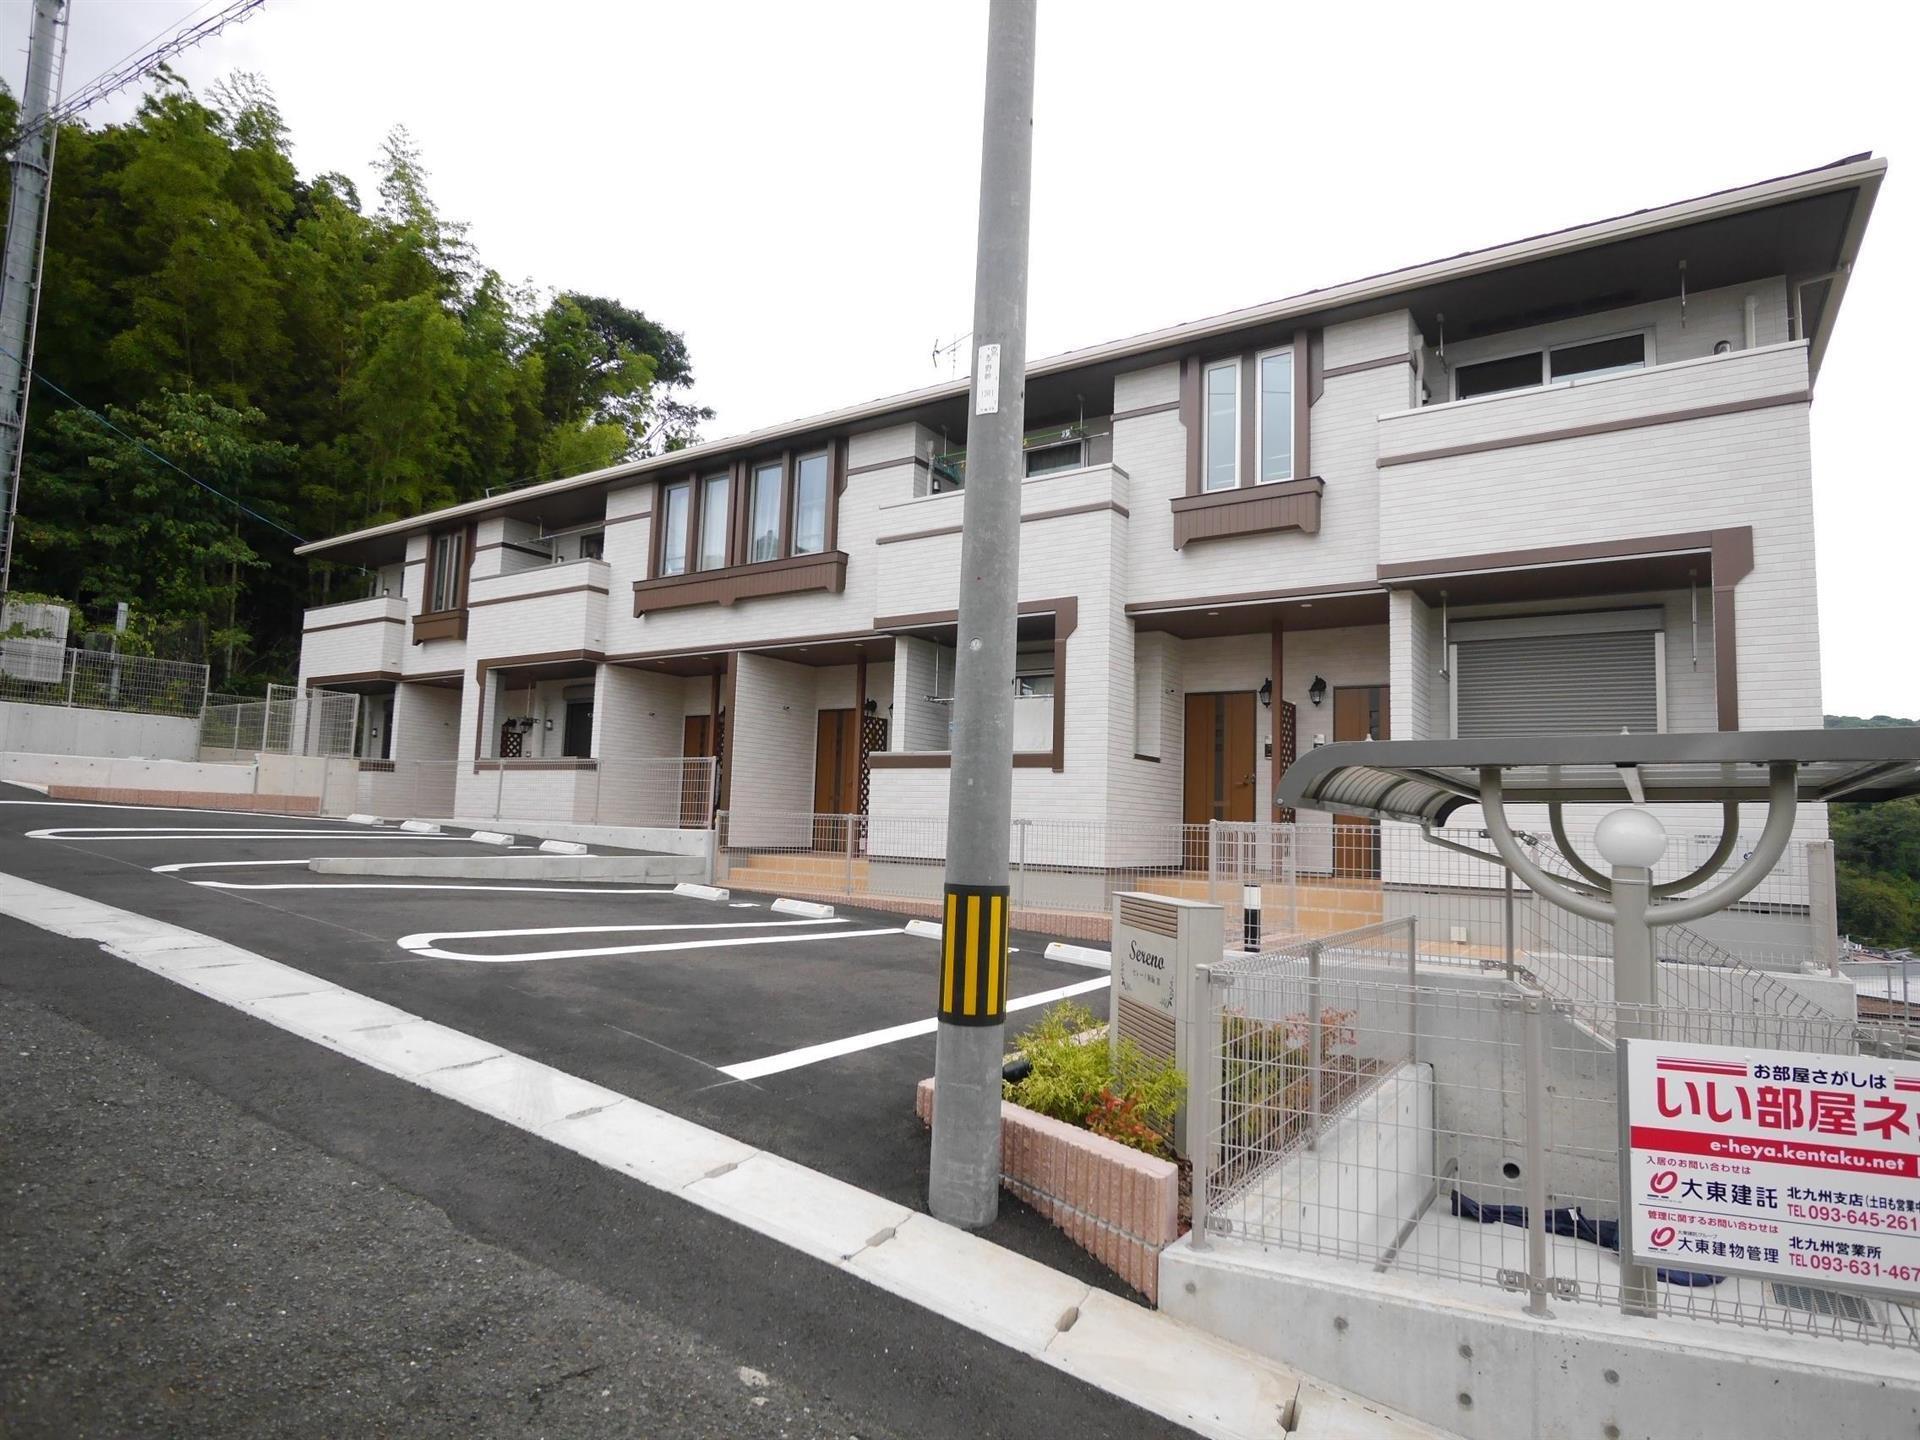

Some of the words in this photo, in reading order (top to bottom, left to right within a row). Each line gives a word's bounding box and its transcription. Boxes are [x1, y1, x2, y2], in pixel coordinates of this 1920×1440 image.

[1129, 940, 1165, 970] Sereno
[1753, 1064, 1887, 1090] お部屋さがしは
[1656, 1077, 1920, 1143] いい部屋ネ
[1646, 1156, 1751, 1175] 入居のお問い合わせは
[1710, 1139, 1905, 1171] e-heya.kentaku.net
[1681, 1179, 1778, 1209] 大東建託
[1648, 1210, 1779, 1234] 管理に関するお問い合わせは
[1787, 1204, 1806, 1218] TEL
[1678, 1237, 1779, 1264] 大東建物管理
[1789, 1236, 1882, 1259] 北九州営業所
[1789, 1253, 1807, 1267] TEL
